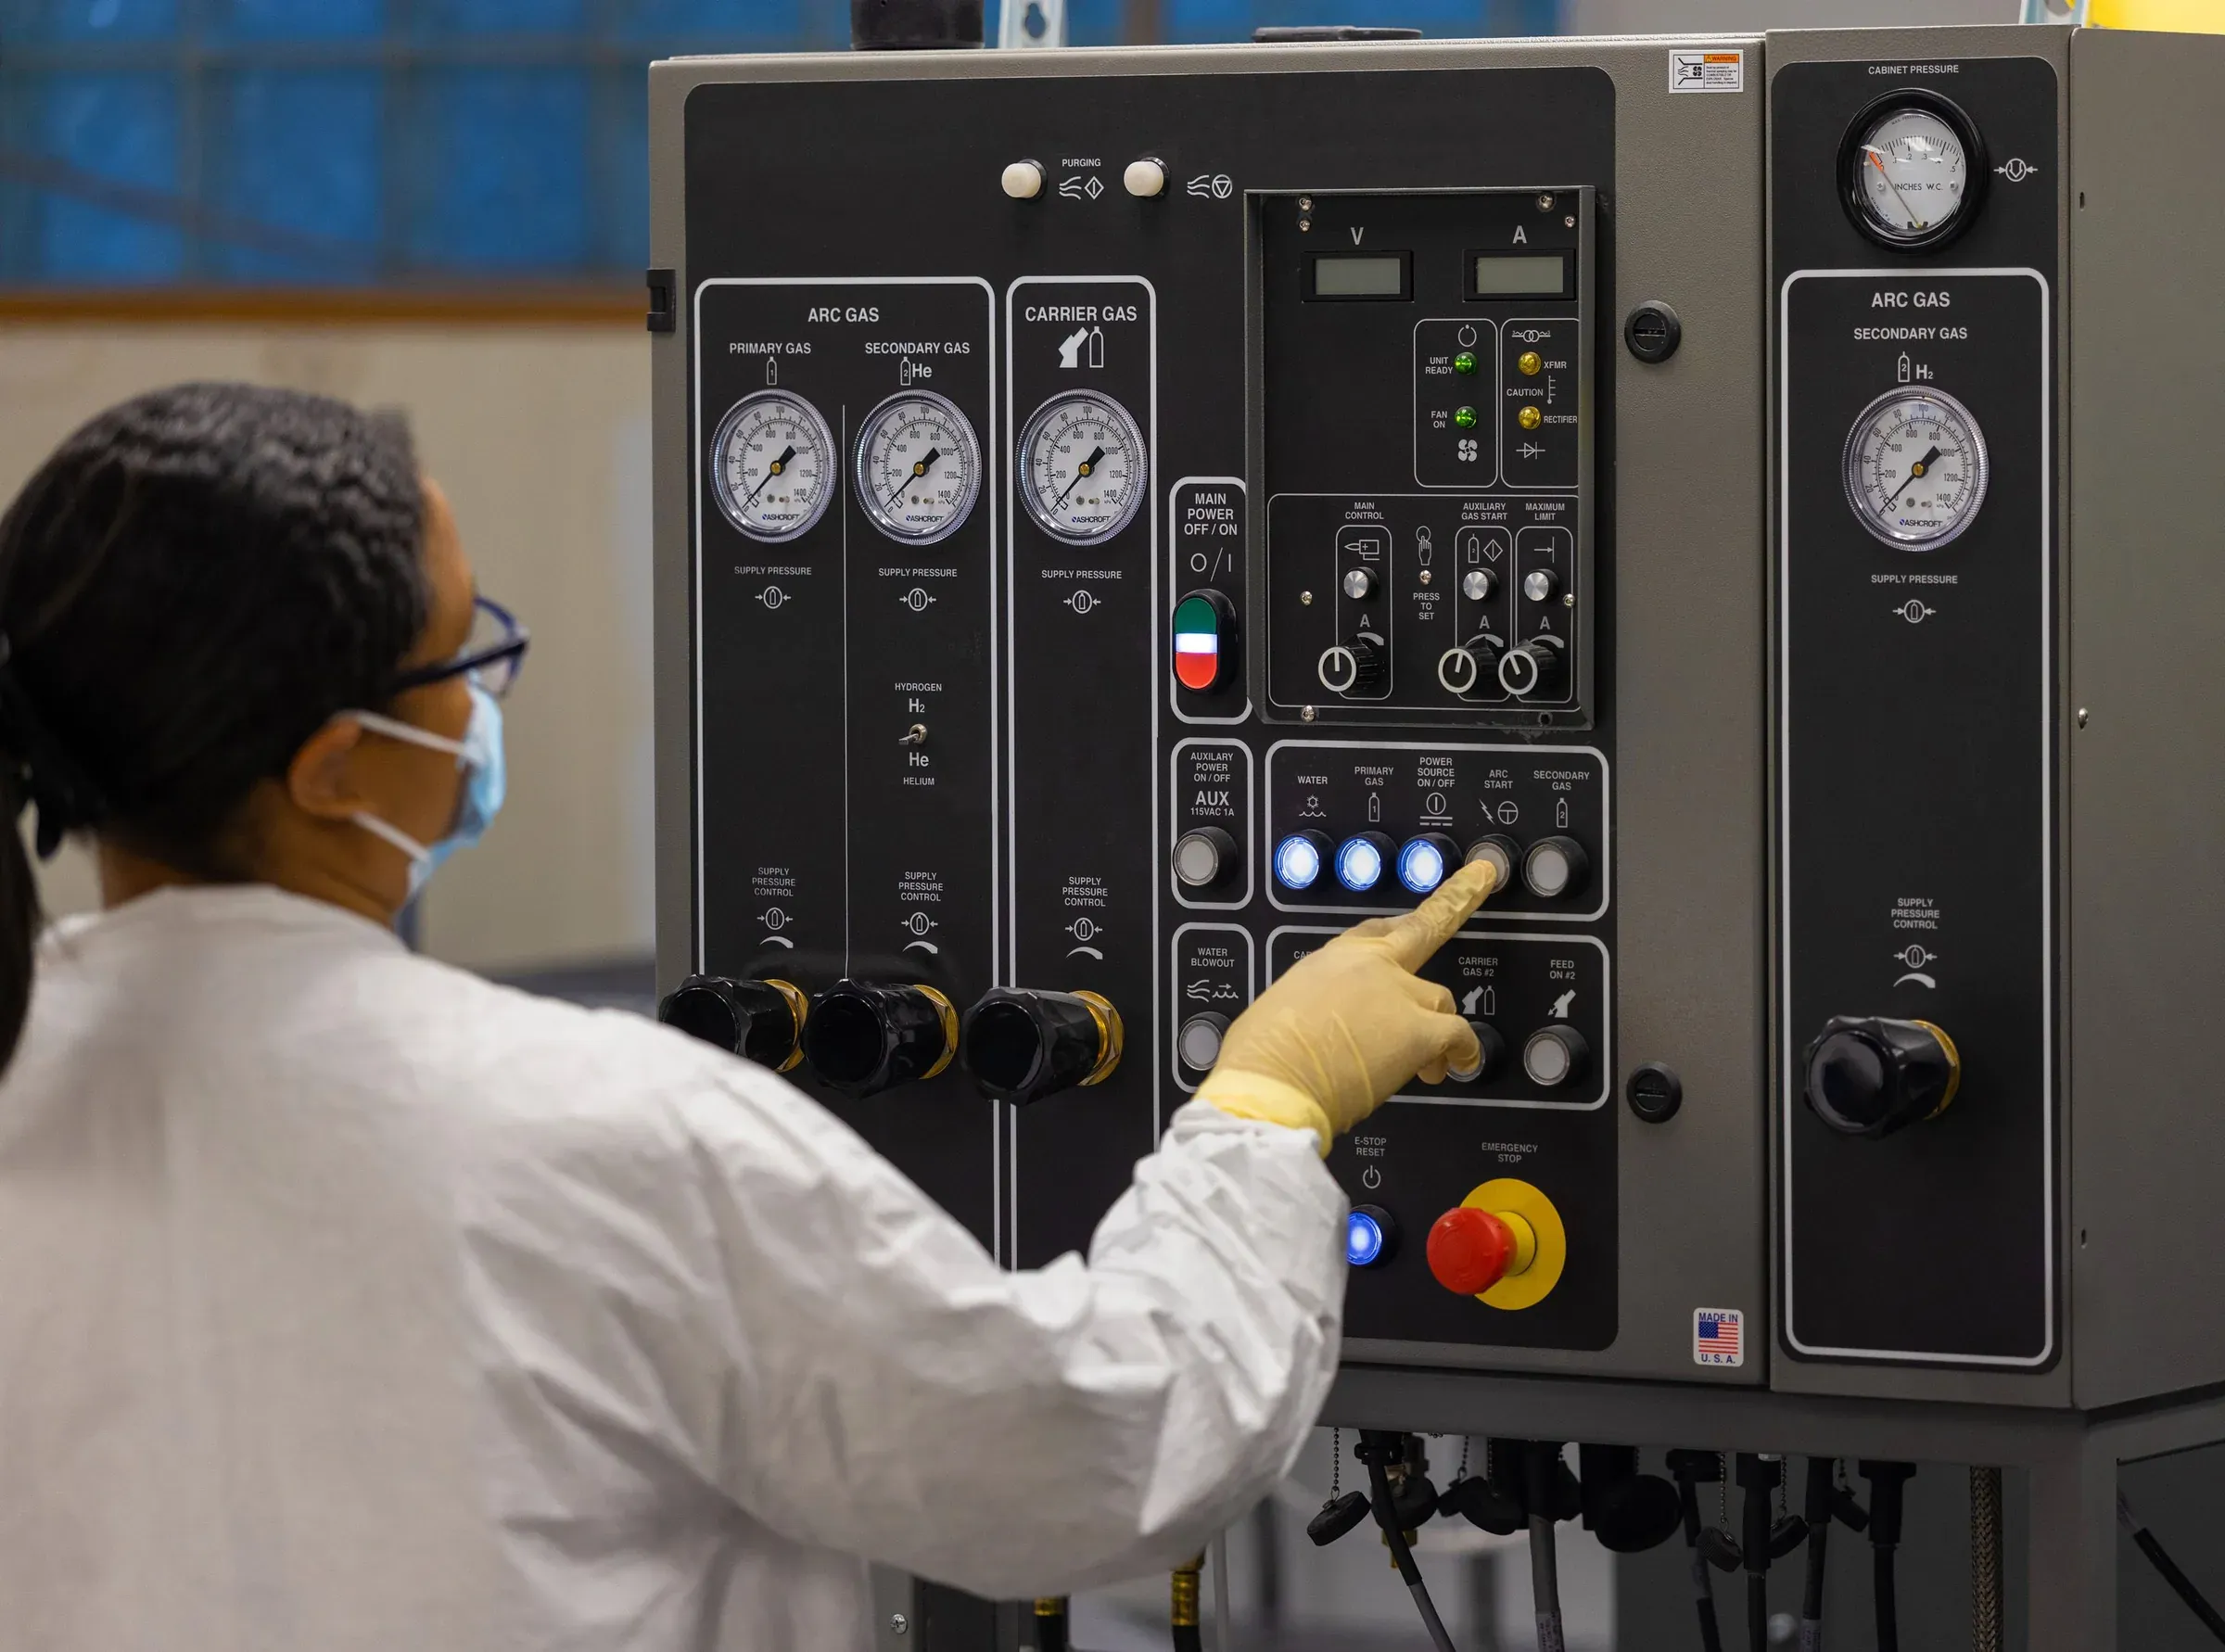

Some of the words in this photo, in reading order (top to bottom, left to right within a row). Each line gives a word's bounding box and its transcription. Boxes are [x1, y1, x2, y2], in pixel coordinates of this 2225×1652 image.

[1869, 66, 1908, 74] CABINET
[1911, 65, 1959, 73] PRESSURE
[1062, 159, 1100, 167] PURGING
[1351, 227, 1364, 245] V
[1513, 225, 1527, 243] A
[1872, 292, 1908, 307] ARC
[1914, 292, 1950, 307] GAS
[808, 308, 840, 322] ARC
[846, 308, 879, 322] GAS
[1025, 307, 1097, 321] CARRIER
[1102, 306, 1137, 321] GAS
[1854, 328, 1936, 339] SECONDARY
[1939, 327, 1967, 339] GAS
[730, 343, 782, 353] PRIMARY
[786, 343, 811, 353] GAS
[866, 342, 940, 353] SECONDARY
[944, 342, 970, 353] GAS
[911, 364, 933, 378] He
[1543, 415, 1578, 425] RECTIFIER
[1073, 431, 1084, 439] 600
[1093, 432, 1105, 440] 800
[1905, 429, 1918, 438] 600
[1928, 432, 1940, 441] 800
[1060, 445, 1071, 454] 400
[1105, 446, 1119, 455] 1000
[1890, 444, 1902, 452] 400
[1056, 470, 1066, 478] 200
[1109, 470, 1123, 478] 1200
[1884, 469, 1897, 478] 200
[1943, 473, 1958, 482] 1200
[1103, 489, 1117, 498] 1400
[1936, 493, 1951, 502] 1400
[1196, 493, 1226, 504] MAIN
[1189, 508, 1233, 519] POWER
[1904, 518, 1943, 527] ASHCROFT
[1185, 524, 1208, 535] OFF
[1219, 524, 1237, 535] ON
[913, 568, 957, 577] PRESSURE
[1872, 575, 1906, 583] SUPPLY
[1909, 575, 1957, 583] PRESSURE
[1414, 592, 1440, 601] PRESS
[1360, 615, 1370, 627] A
[1480, 616, 1490, 629] A
[1540, 616, 1550, 629] A
[909, 752, 929, 767] He
[1190, 753, 1233, 761] AUXILARY
[1420, 757, 1452, 766] POWER
[1197, 763, 1227, 771] POWER
[1354, 767, 1393, 775] PRIMARY
[1418, 768, 1455, 776] SOURCE
[1489, 769, 1507, 778] ARC
[1534, 770, 1589, 782] SECONDARY
[904, 777, 934, 785] HELIUM
[1194, 773, 1206, 782] ON
[1298, 776, 1328, 784] WATER
[1438, 779, 1455, 787] OFF
[1552, 782, 1571, 790] GAS
[1196, 791, 1229, 806] AUX
[1191, 807, 1221, 816] 115VAC
[905, 871, 936, 880] SUPPLY
[753, 878, 795, 886] PRESSURE
[1069, 877, 1100, 885] SUPPLY
[899, 883, 943, 891] PRESSURE
[755, 888, 793, 896] CONTROL
[1062, 887, 1108, 898] PRESSURE
[901, 893, 941, 901] CONTROL
[1065, 897, 1105, 907] CONTROL
[1898, 898, 1933, 907] SUPPLY
[1891, 909, 1939, 918] PRESSURE
[1894, 920, 1938, 929] CONTROL
[1191, 959, 1234, 967] BLOWOUT
[1458, 957, 1497, 965] CARRIER
[1551, 959, 1574, 972] FEED
[1463, 968, 1481, 976] GAS
[1550, 971, 1562, 979] ON
[1355, 1137, 1386, 1145] E-STOP
[1482, 1142, 1538, 1152] EMERGENCY
[1356, 1148, 1384, 1156] RESET
[1498, 1154, 1521, 1163] STOP
[1698, 1312, 1726, 1322] MADE
[1728, 1313, 1738, 1323] IN
